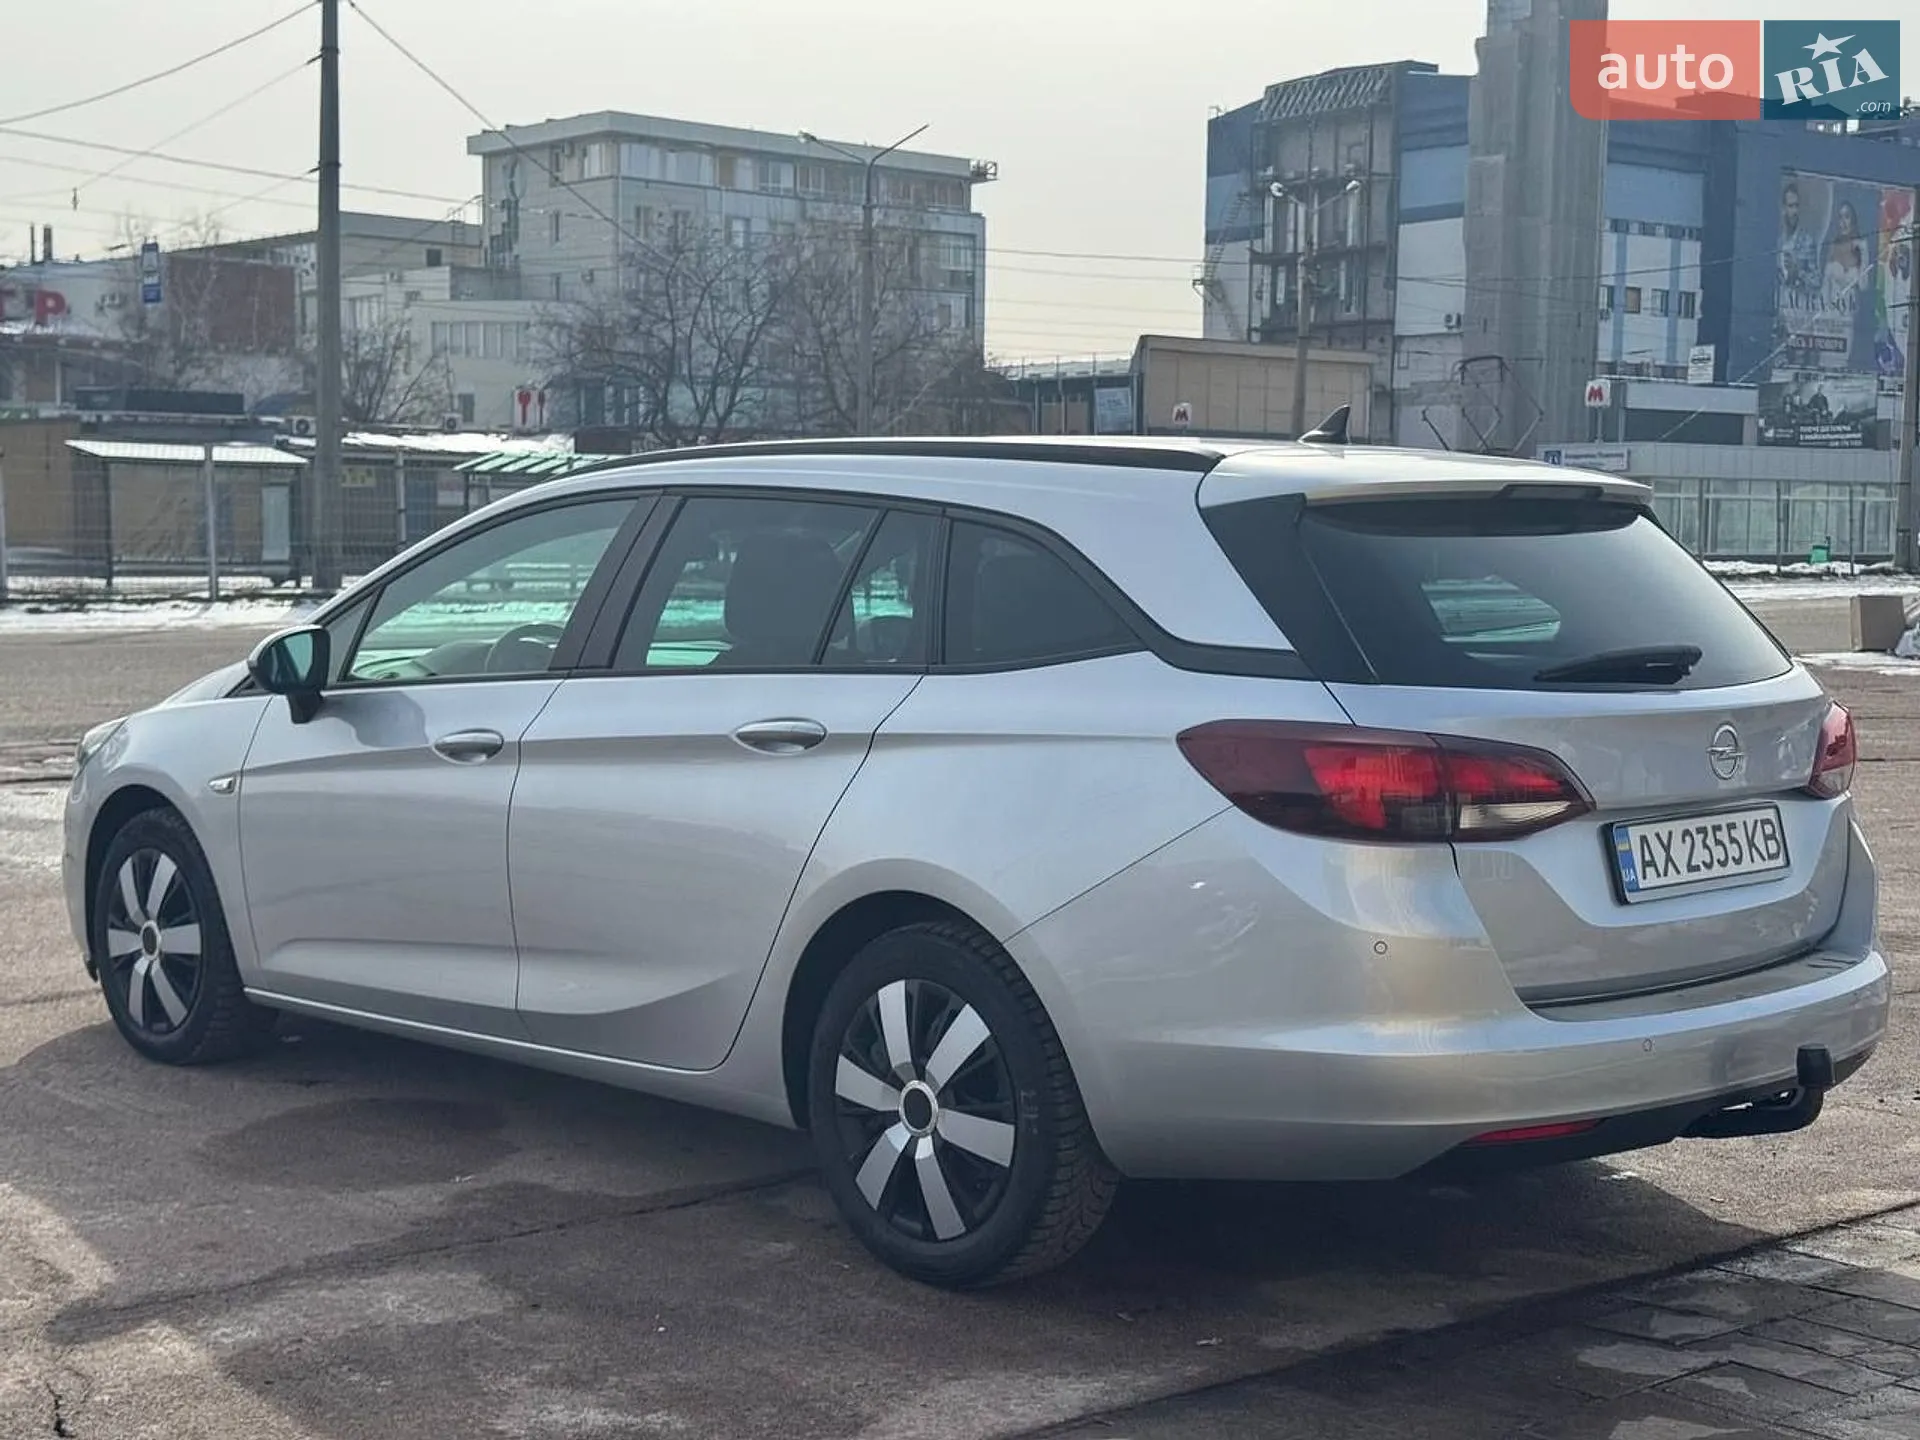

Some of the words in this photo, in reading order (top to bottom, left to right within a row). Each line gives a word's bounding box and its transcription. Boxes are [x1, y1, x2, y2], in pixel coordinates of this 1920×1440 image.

[1639, 830, 1681, 880] AX
[1681, 822, 1744, 874] 2355
[1743, 817, 1782, 864] KB
